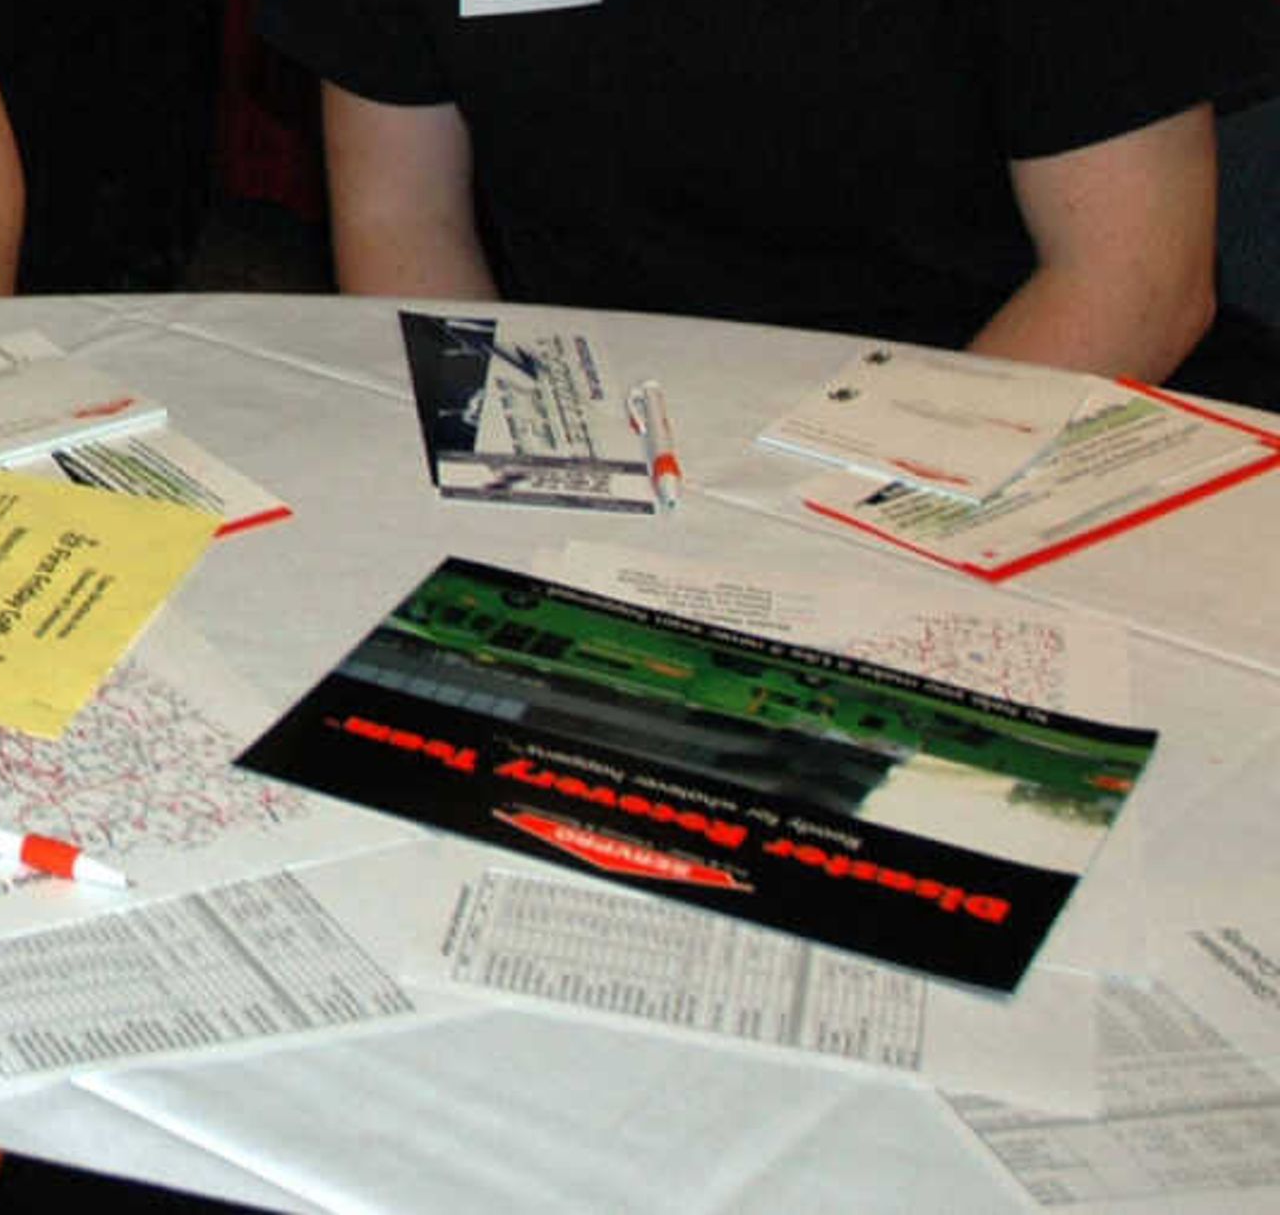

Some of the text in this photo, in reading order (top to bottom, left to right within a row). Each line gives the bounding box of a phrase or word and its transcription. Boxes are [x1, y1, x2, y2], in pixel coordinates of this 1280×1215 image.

[492, 758, 749, 849] Recovery
[631, 774, 740, 813] whatever
[746, 806, 781, 826] for
[762, 838, 1012, 925] Disaster
